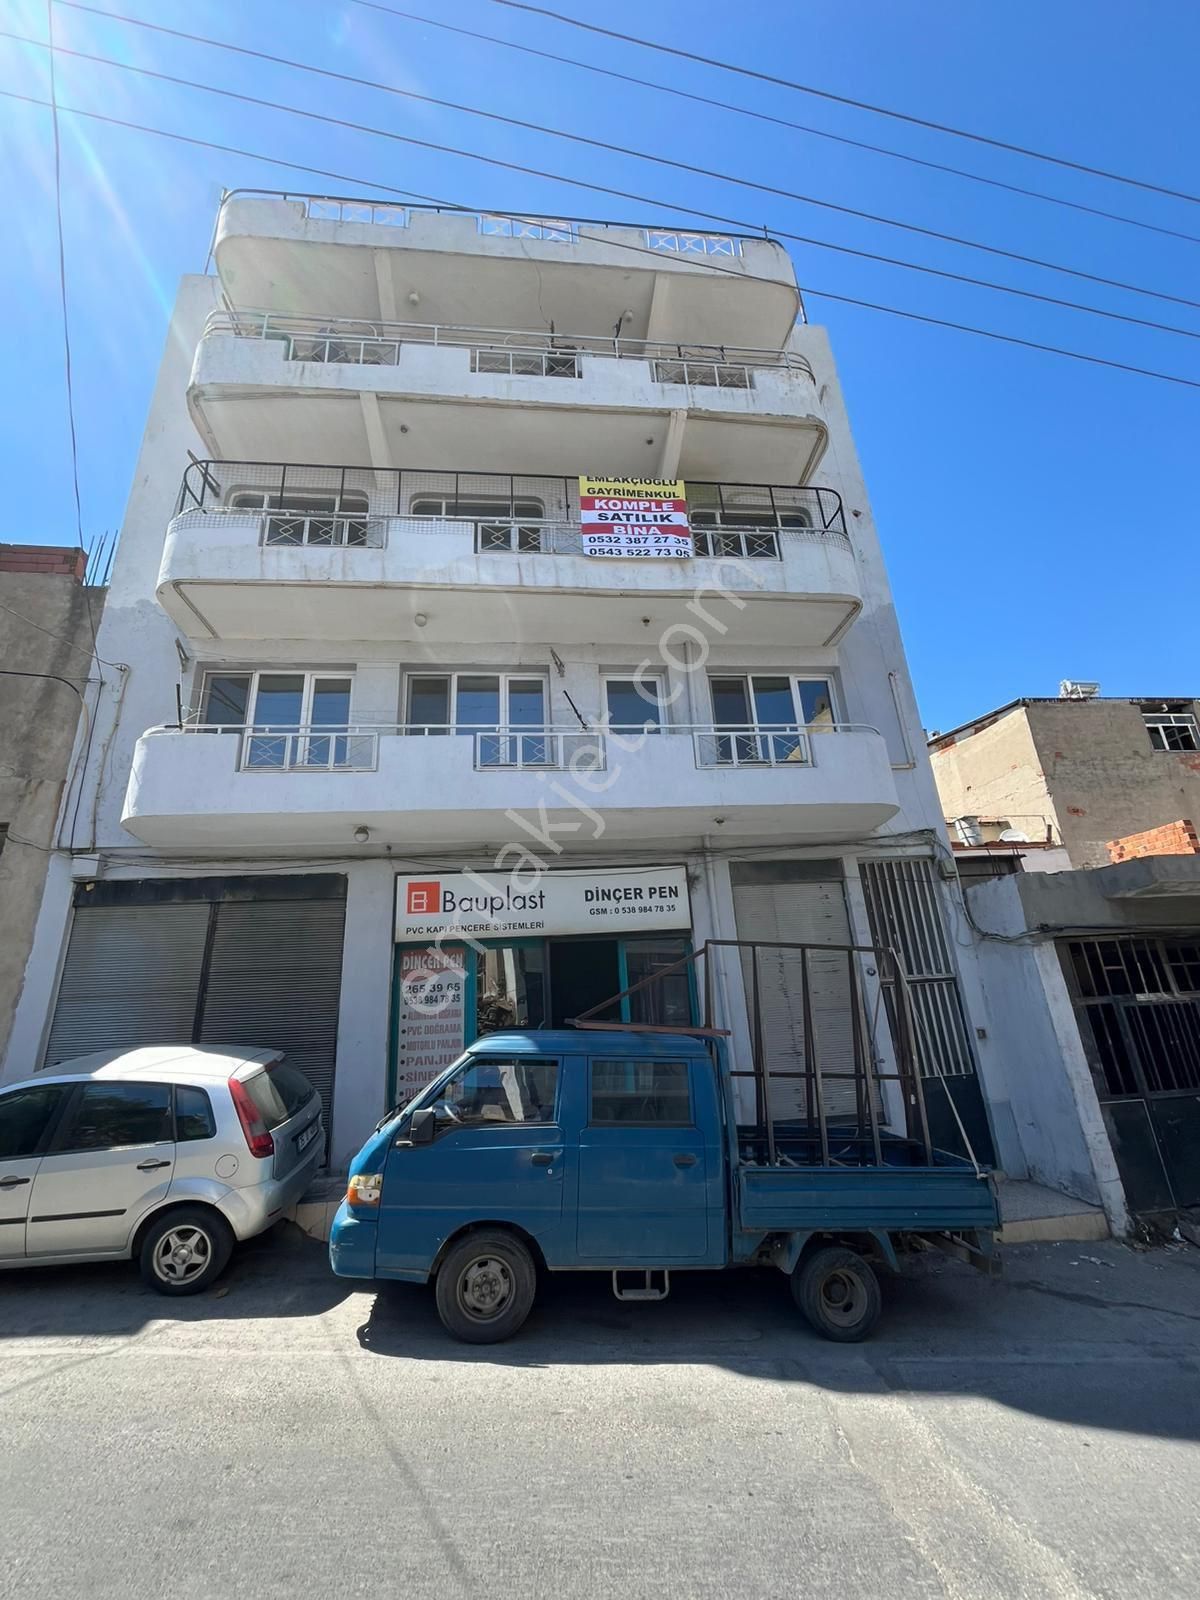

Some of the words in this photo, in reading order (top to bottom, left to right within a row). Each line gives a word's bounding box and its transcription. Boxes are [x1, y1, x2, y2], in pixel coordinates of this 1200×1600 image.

[587, 487, 680, 498] GAYRİMENKUL
[594, 499, 675, 512] KOMPLE
[597, 512, 673, 523] SATILIK
[613, 524, 662, 535] BİNA
[588, 536, 621, 544] 0532
[625, 536, 648, 545] 387
[654, 536, 669, 544] 27
[674, 537, 689, 546] 35
[589, 548, 622, 556] 0543
[626, 548, 651, 557] 522
[655, 548, 672, 557] 73
[675, 548, 690, 558] 05
[584, 886, 643, 904] DİNÇER
[648, 885, 679, 899] PEN
[443, 884, 546, 918] Bauplast
[621, 906, 636, 914] 538
[638, 905, 653, 913] 984
[666, 904, 676, 912] 35
[406, 926, 424, 935] PVC
[449, 923, 491, 932] PENCERE
[429, 983, 443, 993] 39
[407, 1026, 423, 1036] PVC
